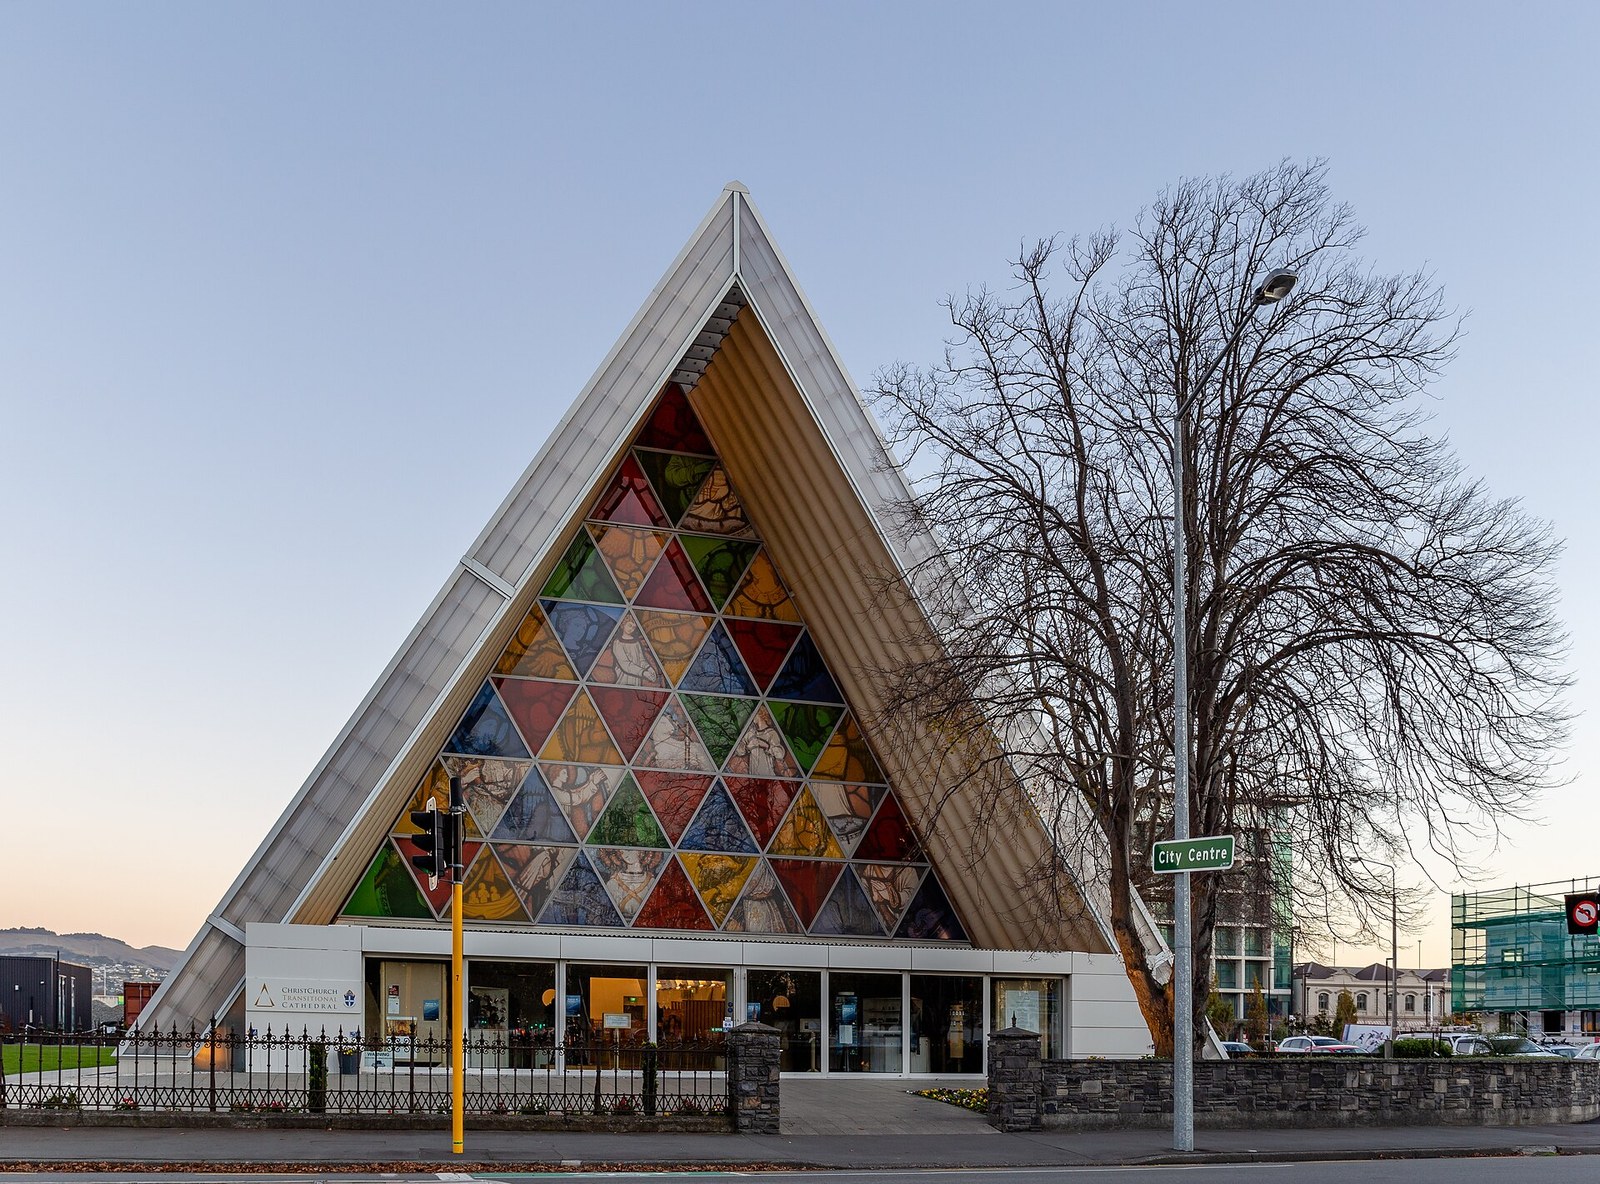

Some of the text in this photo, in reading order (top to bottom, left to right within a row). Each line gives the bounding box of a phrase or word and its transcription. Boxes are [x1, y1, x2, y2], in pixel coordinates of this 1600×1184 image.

[1158, 846, 1228, 866] City Centre
[281, 987, 338, 995] CHRISTCHURCH
[282, 994, 338, 1002] TRANSITIONAL
[281, 1002, 338, 1010] CATHEDRAL
